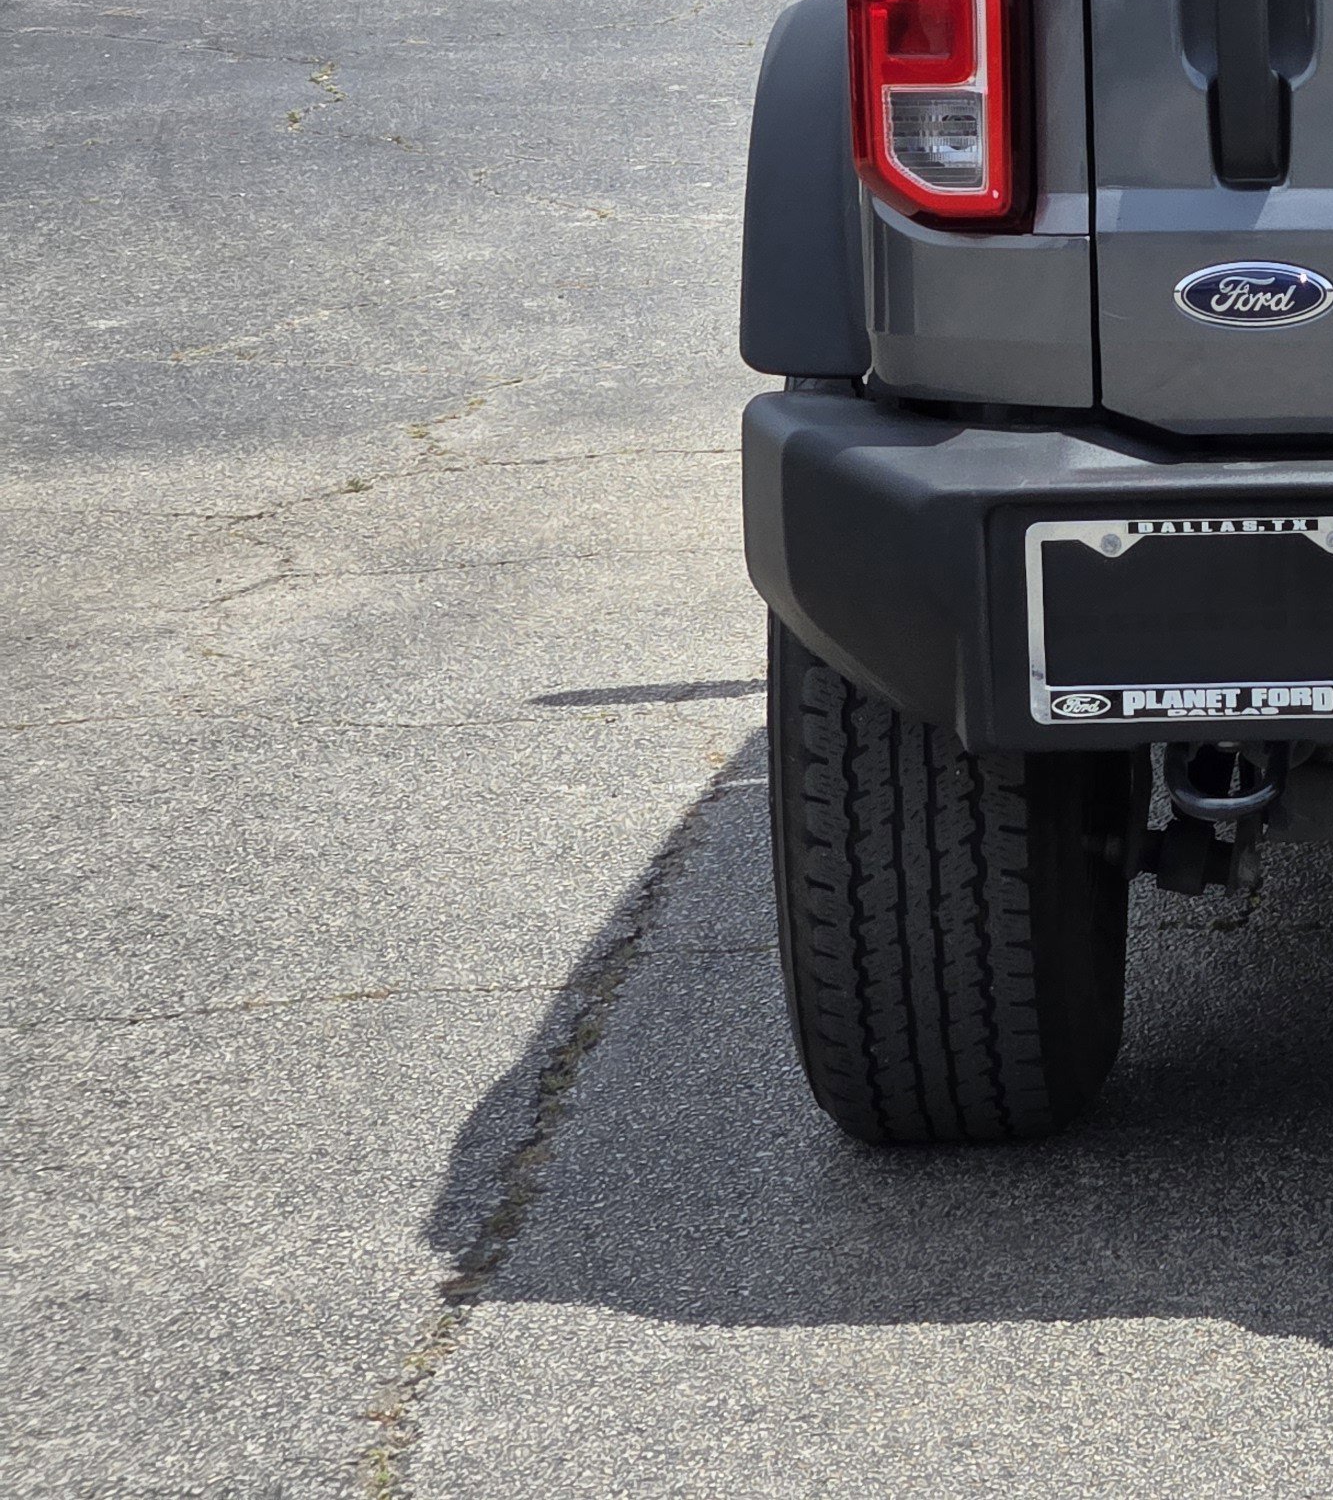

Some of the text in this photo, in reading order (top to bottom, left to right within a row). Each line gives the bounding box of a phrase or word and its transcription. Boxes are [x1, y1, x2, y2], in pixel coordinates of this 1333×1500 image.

[1211, 276, 1297, 312] Ford
[1063, 696, 1100, 713] Ford
[1123, 687, 1333, 716] PLANET FORD
[1167, 707, 1279, 717] DALLAS
